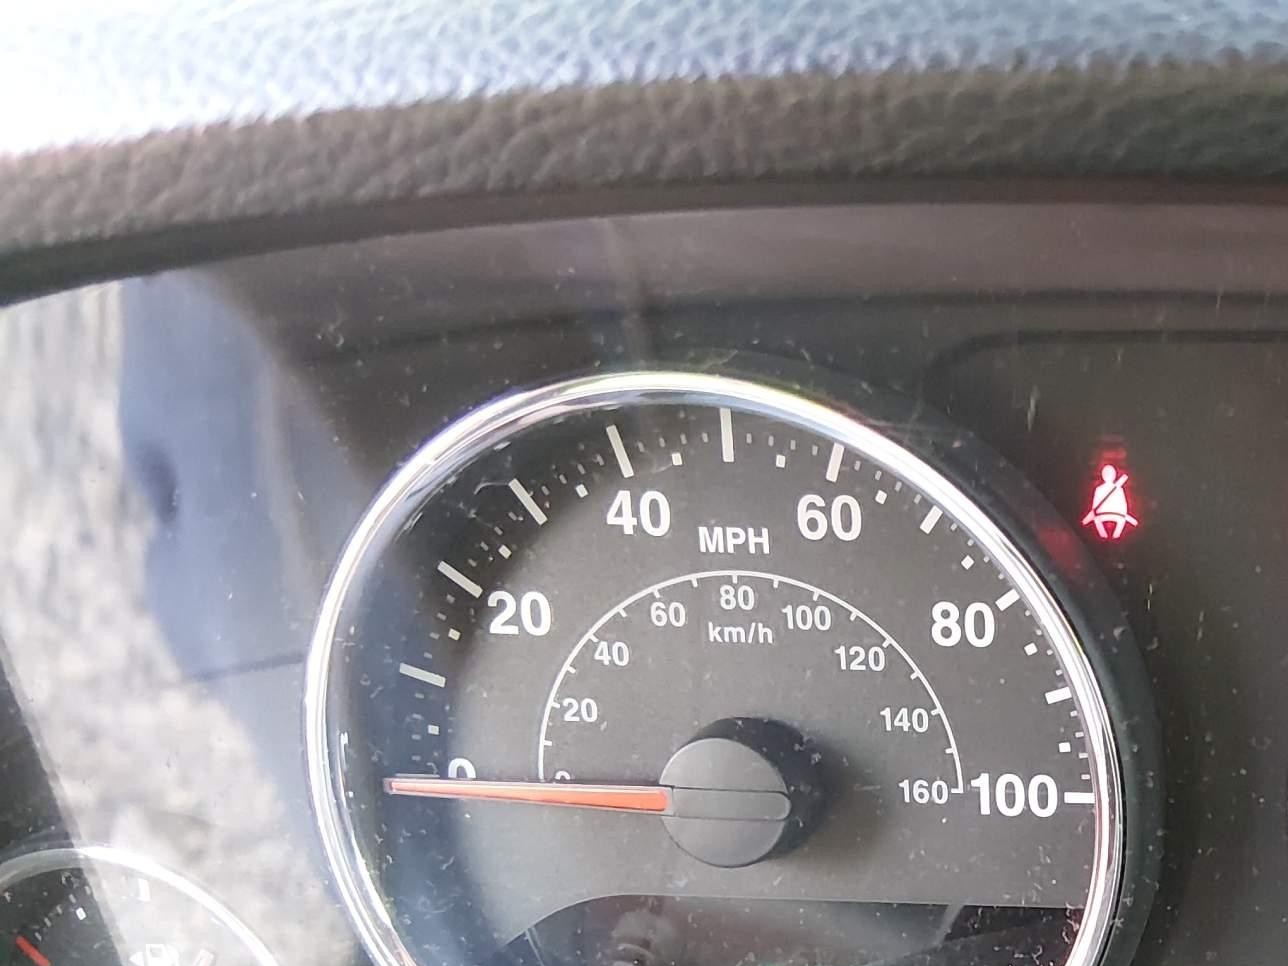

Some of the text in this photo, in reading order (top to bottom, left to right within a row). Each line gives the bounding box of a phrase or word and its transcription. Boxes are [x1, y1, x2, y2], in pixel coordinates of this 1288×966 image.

[606, 490, 671, 537] 40
[797, 494, 862, 541] 60
[698, 526, 770, 555] MPH
[719, 585, 756, 611] 80
[487, 590, 552, 637] 20
[650, 601, 686, 627] 60
[781, 604, 832, 631] 100
[931, 601, 996, 648] 80
[708, 621, 773, 644] km/h
[594, 641, 630, 667] 40
[834, 645, 886, 672] 120
[562, 697, 598, 723] 20
[879, 707, 929, 733] 140
[898, 779, 949, 805] 160
[970, 772, 1058, 818] 100
